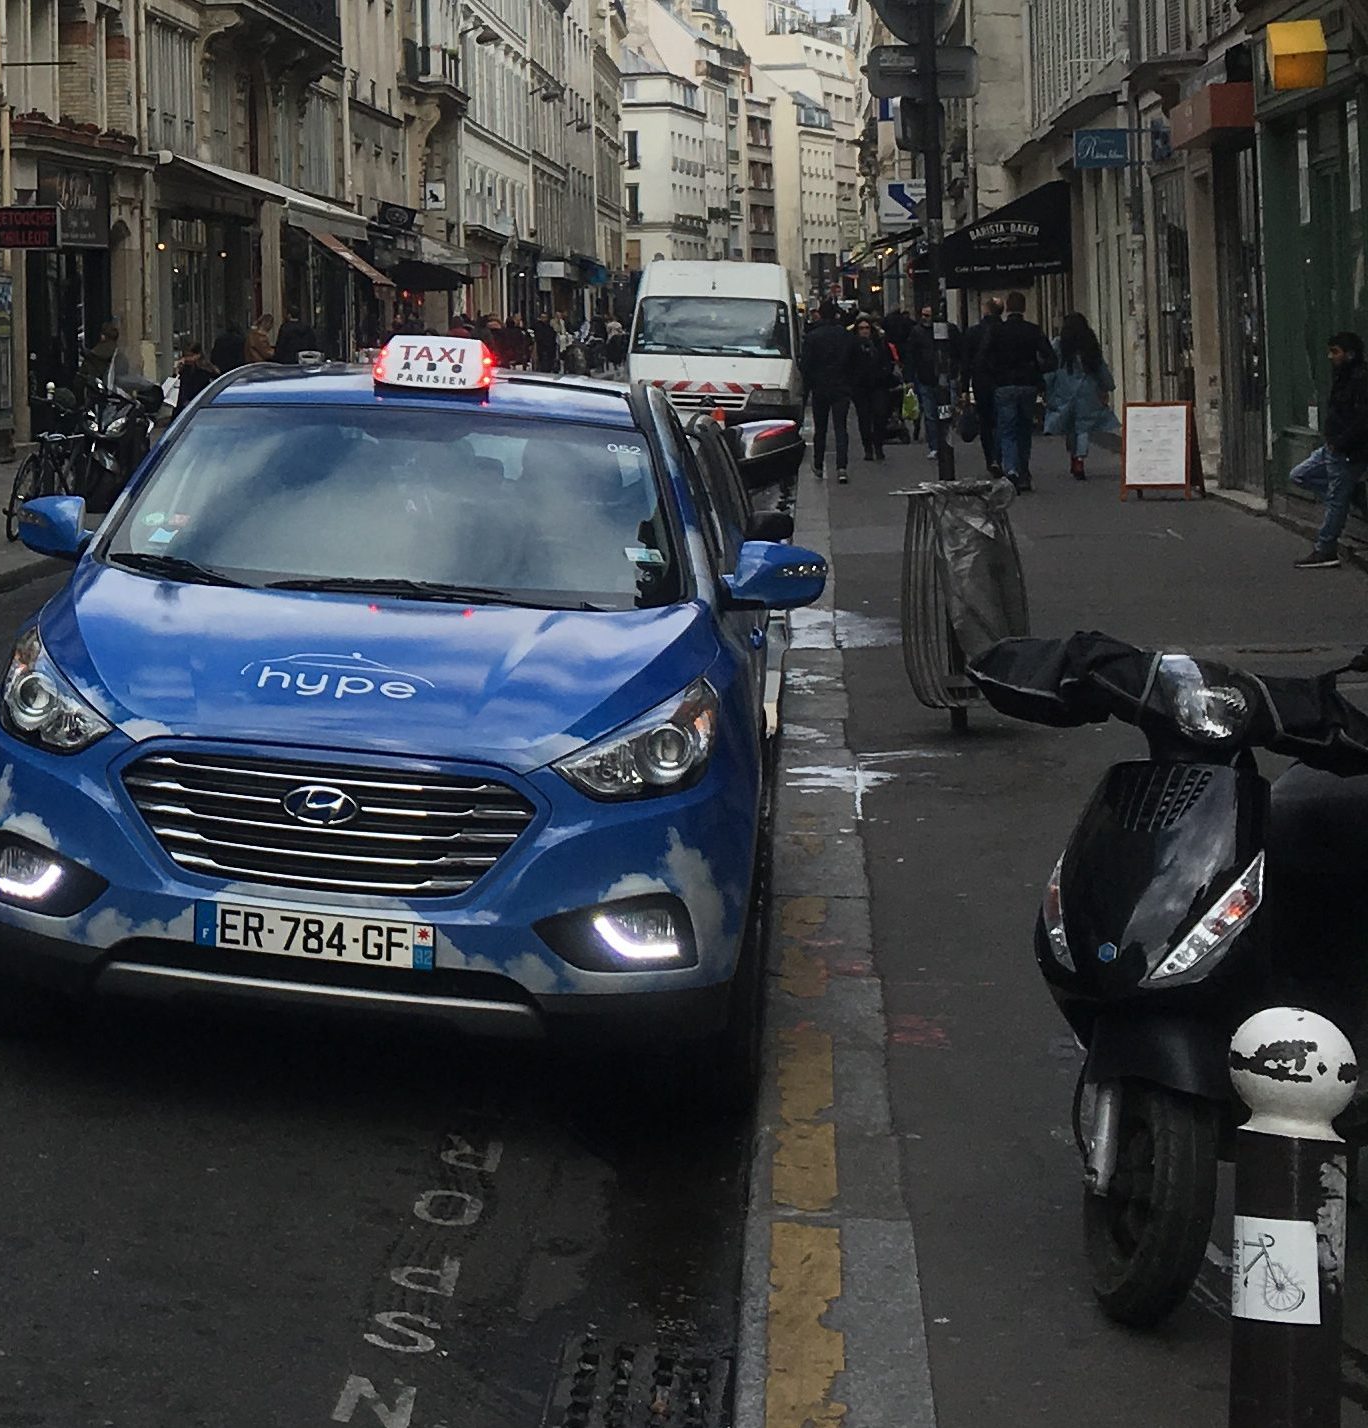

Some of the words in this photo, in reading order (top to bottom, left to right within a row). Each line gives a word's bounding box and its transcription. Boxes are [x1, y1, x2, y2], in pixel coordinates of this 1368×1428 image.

[969, 223, 1007, 241] BARISTA
[1010, 223, 1040, 236] BAKER
[400, 345, 466, 364] TAXI
[396, 373, 467, 386] PARISIEN
[606, 443, 642, 456] 052
[257, 665, 417, 699] hype
[202, 928, 210, 939] F
[220, 908, 408, 962] ER-784-GF
